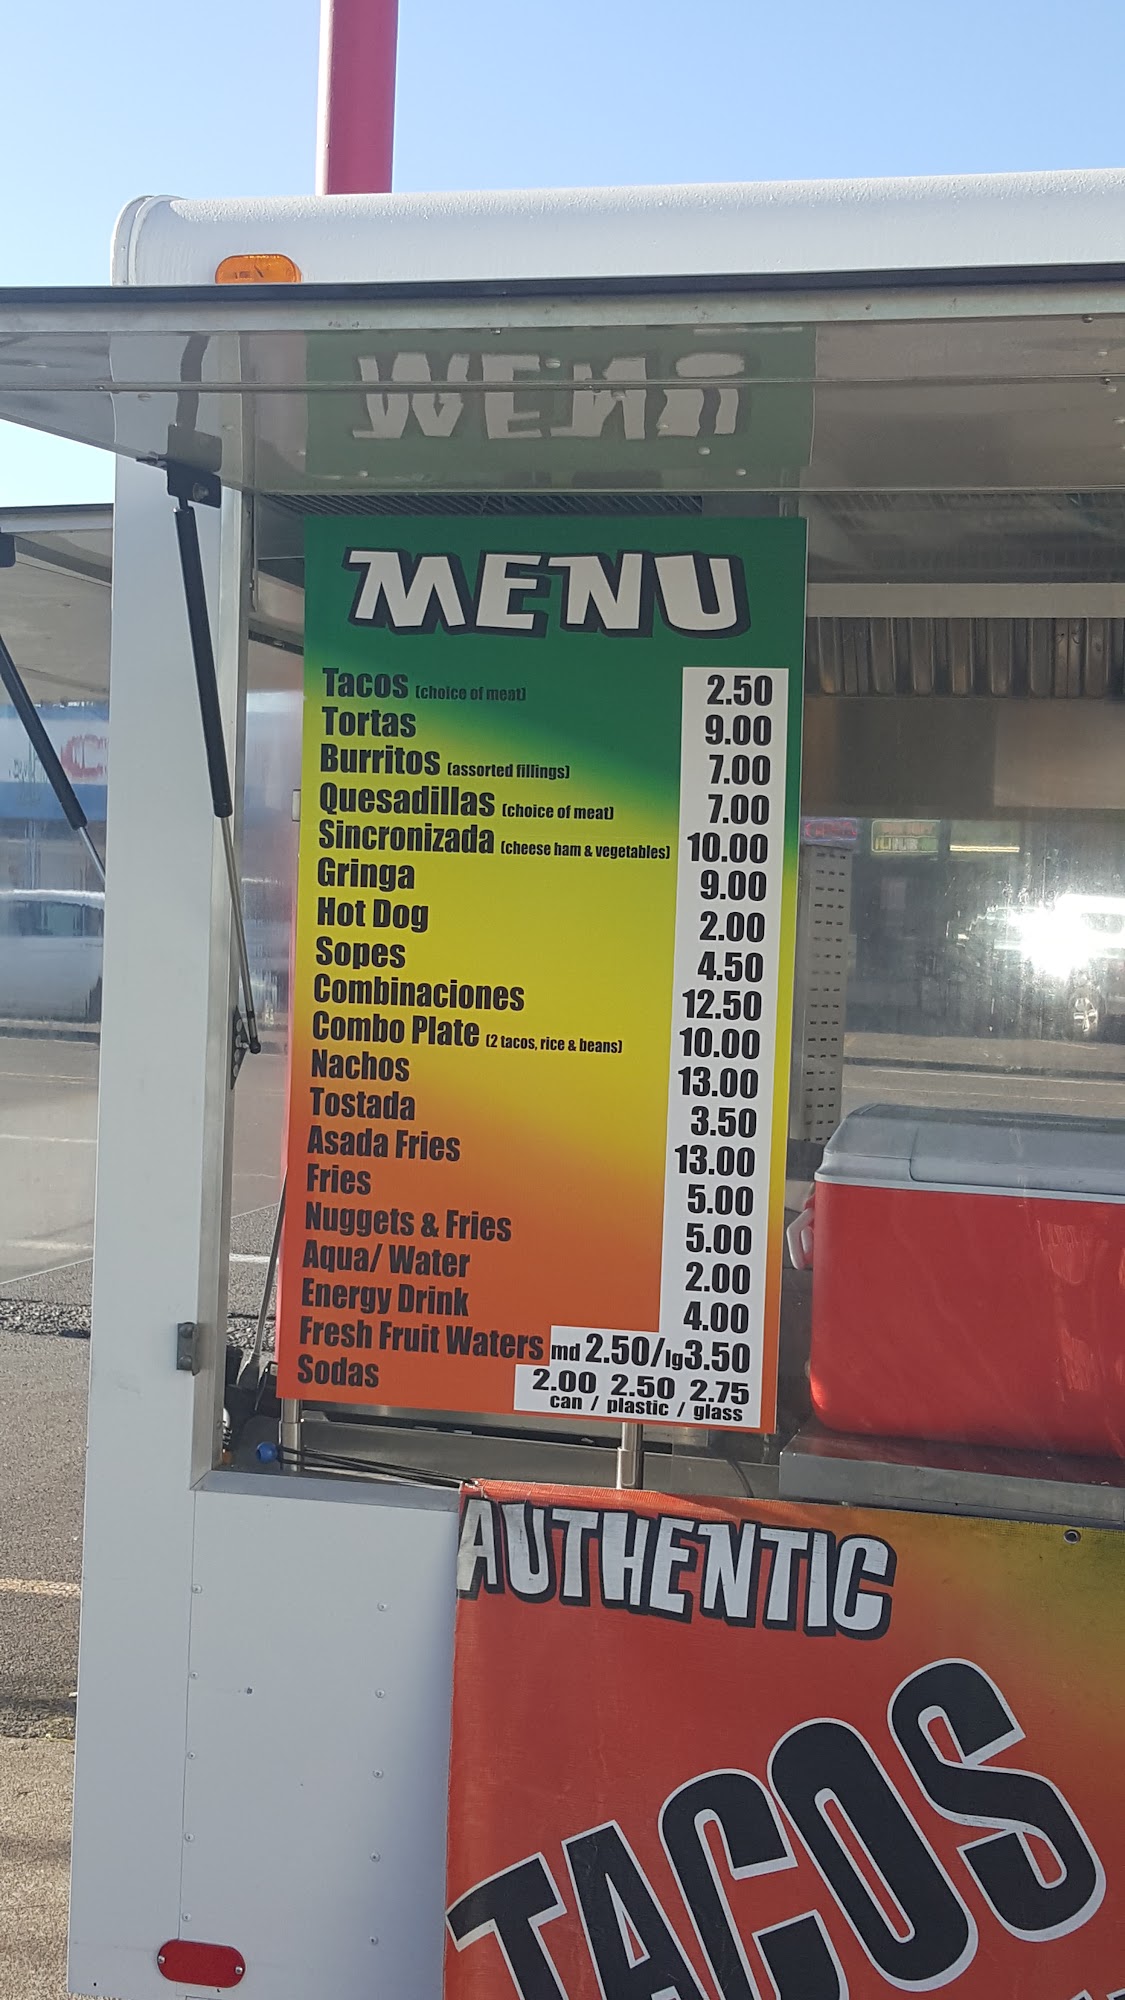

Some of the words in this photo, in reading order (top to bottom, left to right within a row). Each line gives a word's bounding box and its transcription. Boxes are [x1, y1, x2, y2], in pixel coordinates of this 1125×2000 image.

[345, 547, 750, 638] MENU
[322, 667, 409, 699] Tacos
[469, 686, 484, 701] of
[706, 674, 773, 707] 2.50
[321, 705, 417, 738] Tortas
[704, 713, 772, 747] 9.00
[320, 742, 441, 776] Burritos
[708, 753, 771, 786] 7.00
[319, 781, 496, 817] Quesadillas
[556, 804, 572, 819] of
[707, 793, 770, 826] 7.00
[318, 818, 495, 855] Sincronizada
[553, 841, 582, 857] ham
[583, 844, 594, 858] &
[686, 831, 769, 865] 10.00
[317, 856, 415, 893] Gringa
[699, 869, 767, 902] 9.00
[316, 896, 367, 928] Hot
[372, 898, 429, 934] Dog
[699, 910, 766, 943] 2.00
[315, 935, 406, 970] Sopes
[697, 950, 764, 983] 4.50
[313, 972, 525, 1012] Combinaciones
[681, 988, 762, 1022] 12.50
[312, 1010, 406, 1044] Combo
[411, 1014, 480, 1048] Plate
[500, 1035, 538, 1051] tacos,
[540, 1036, 566, 1051] rice
[567, 1039, 577, 1052] &
[678, 1026, 761, 1060] 10.00
[311, 1048, 410, 1083] Nachos
[677, 1066, 759, 1100] 13.00
[309, 1086, 416, 1121] Tostada
[690, 1105, 757, 1139] 3.50
[306, 1124, 389, 1158] Asada
[395, 1129, 461, 1162] Fries
[674, 1144, 756, 1178] 13.00
[306, 1162, 372, 1196] Fries
[687, 1183, 754, 1217] 5.00
[304, 1201, 415, 1238] Nuggets
[420, 1212, 440, 1238] &
[445, 1209, 512, 1242] Fries
[685, 1222, 753, 1256] 5.00
[388, 1244, 471, 1278] Water
[684, 1261, 751, 1295] 2.00
[301, 1277, 393, 1315] Energy
[397, 1283, 469, 1317] Drink
[682, 1300, 750, 1335] 4.00
[299, 1315, 373, 1349] Fresh
[378, 1320, 440, 1354] Fruit
[445, 1324, 545, 1361] Waters
[550, 1342, 581, 1362] md
[297, 1353, 379, 1389] Sodas
[532, 1367, 597, 1395] 2.00
[610, 1373, 676, 1400] 2.50
[689, 1378, 750, 1406] 2.75
[549, 1394, 583, 1410] can
[590, 1395, 600, 1412] /
[606, 1397, 670, 1417] plastic
[676, 1401, 686, 1418] /
[693, 1403, 743, 1422] glass
[457, 1498, 897, 1639] AUTHENTIC
[446, 1657, 1106, 2000] TACOS
